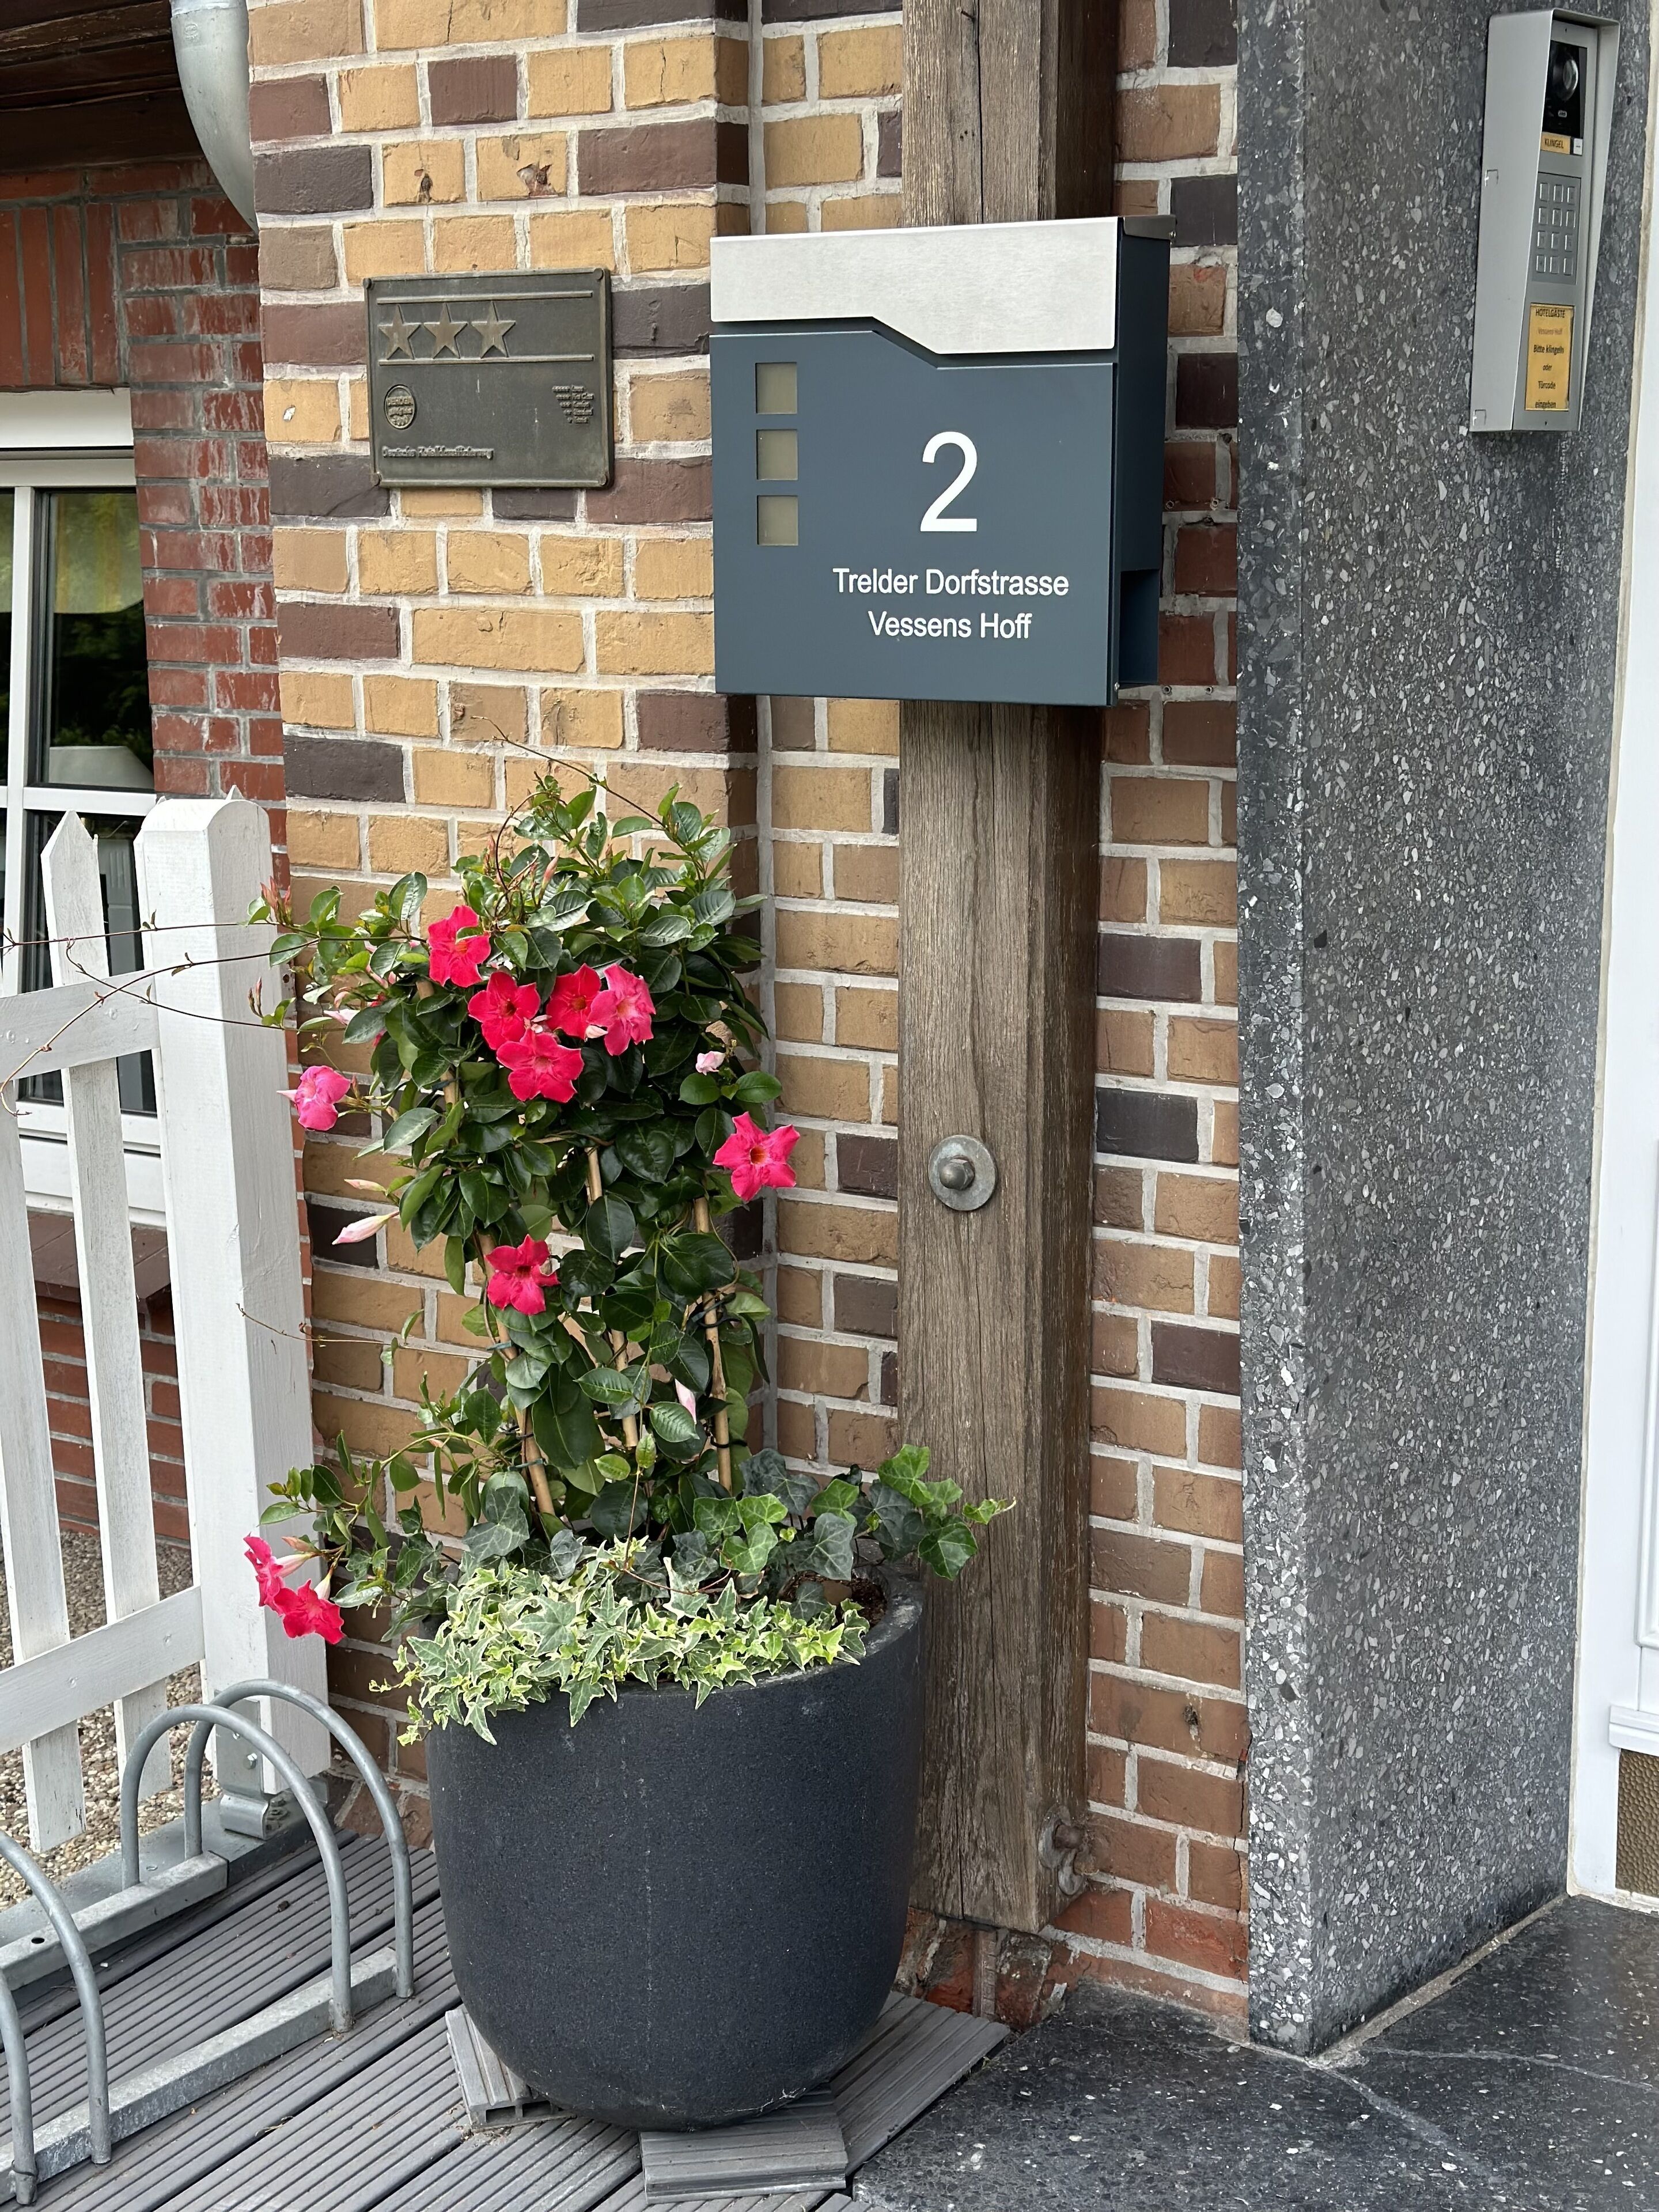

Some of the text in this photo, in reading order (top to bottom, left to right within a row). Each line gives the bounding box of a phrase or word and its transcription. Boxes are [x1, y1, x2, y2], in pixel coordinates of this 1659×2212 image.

[1533, 344, 1545, 353] Bitte
[920, 431, 978, 532] 2
[832, 568, 1069, 596] Trelder Dorfstrasse
[868, 611, 1033, 639] Vessens Hoff
